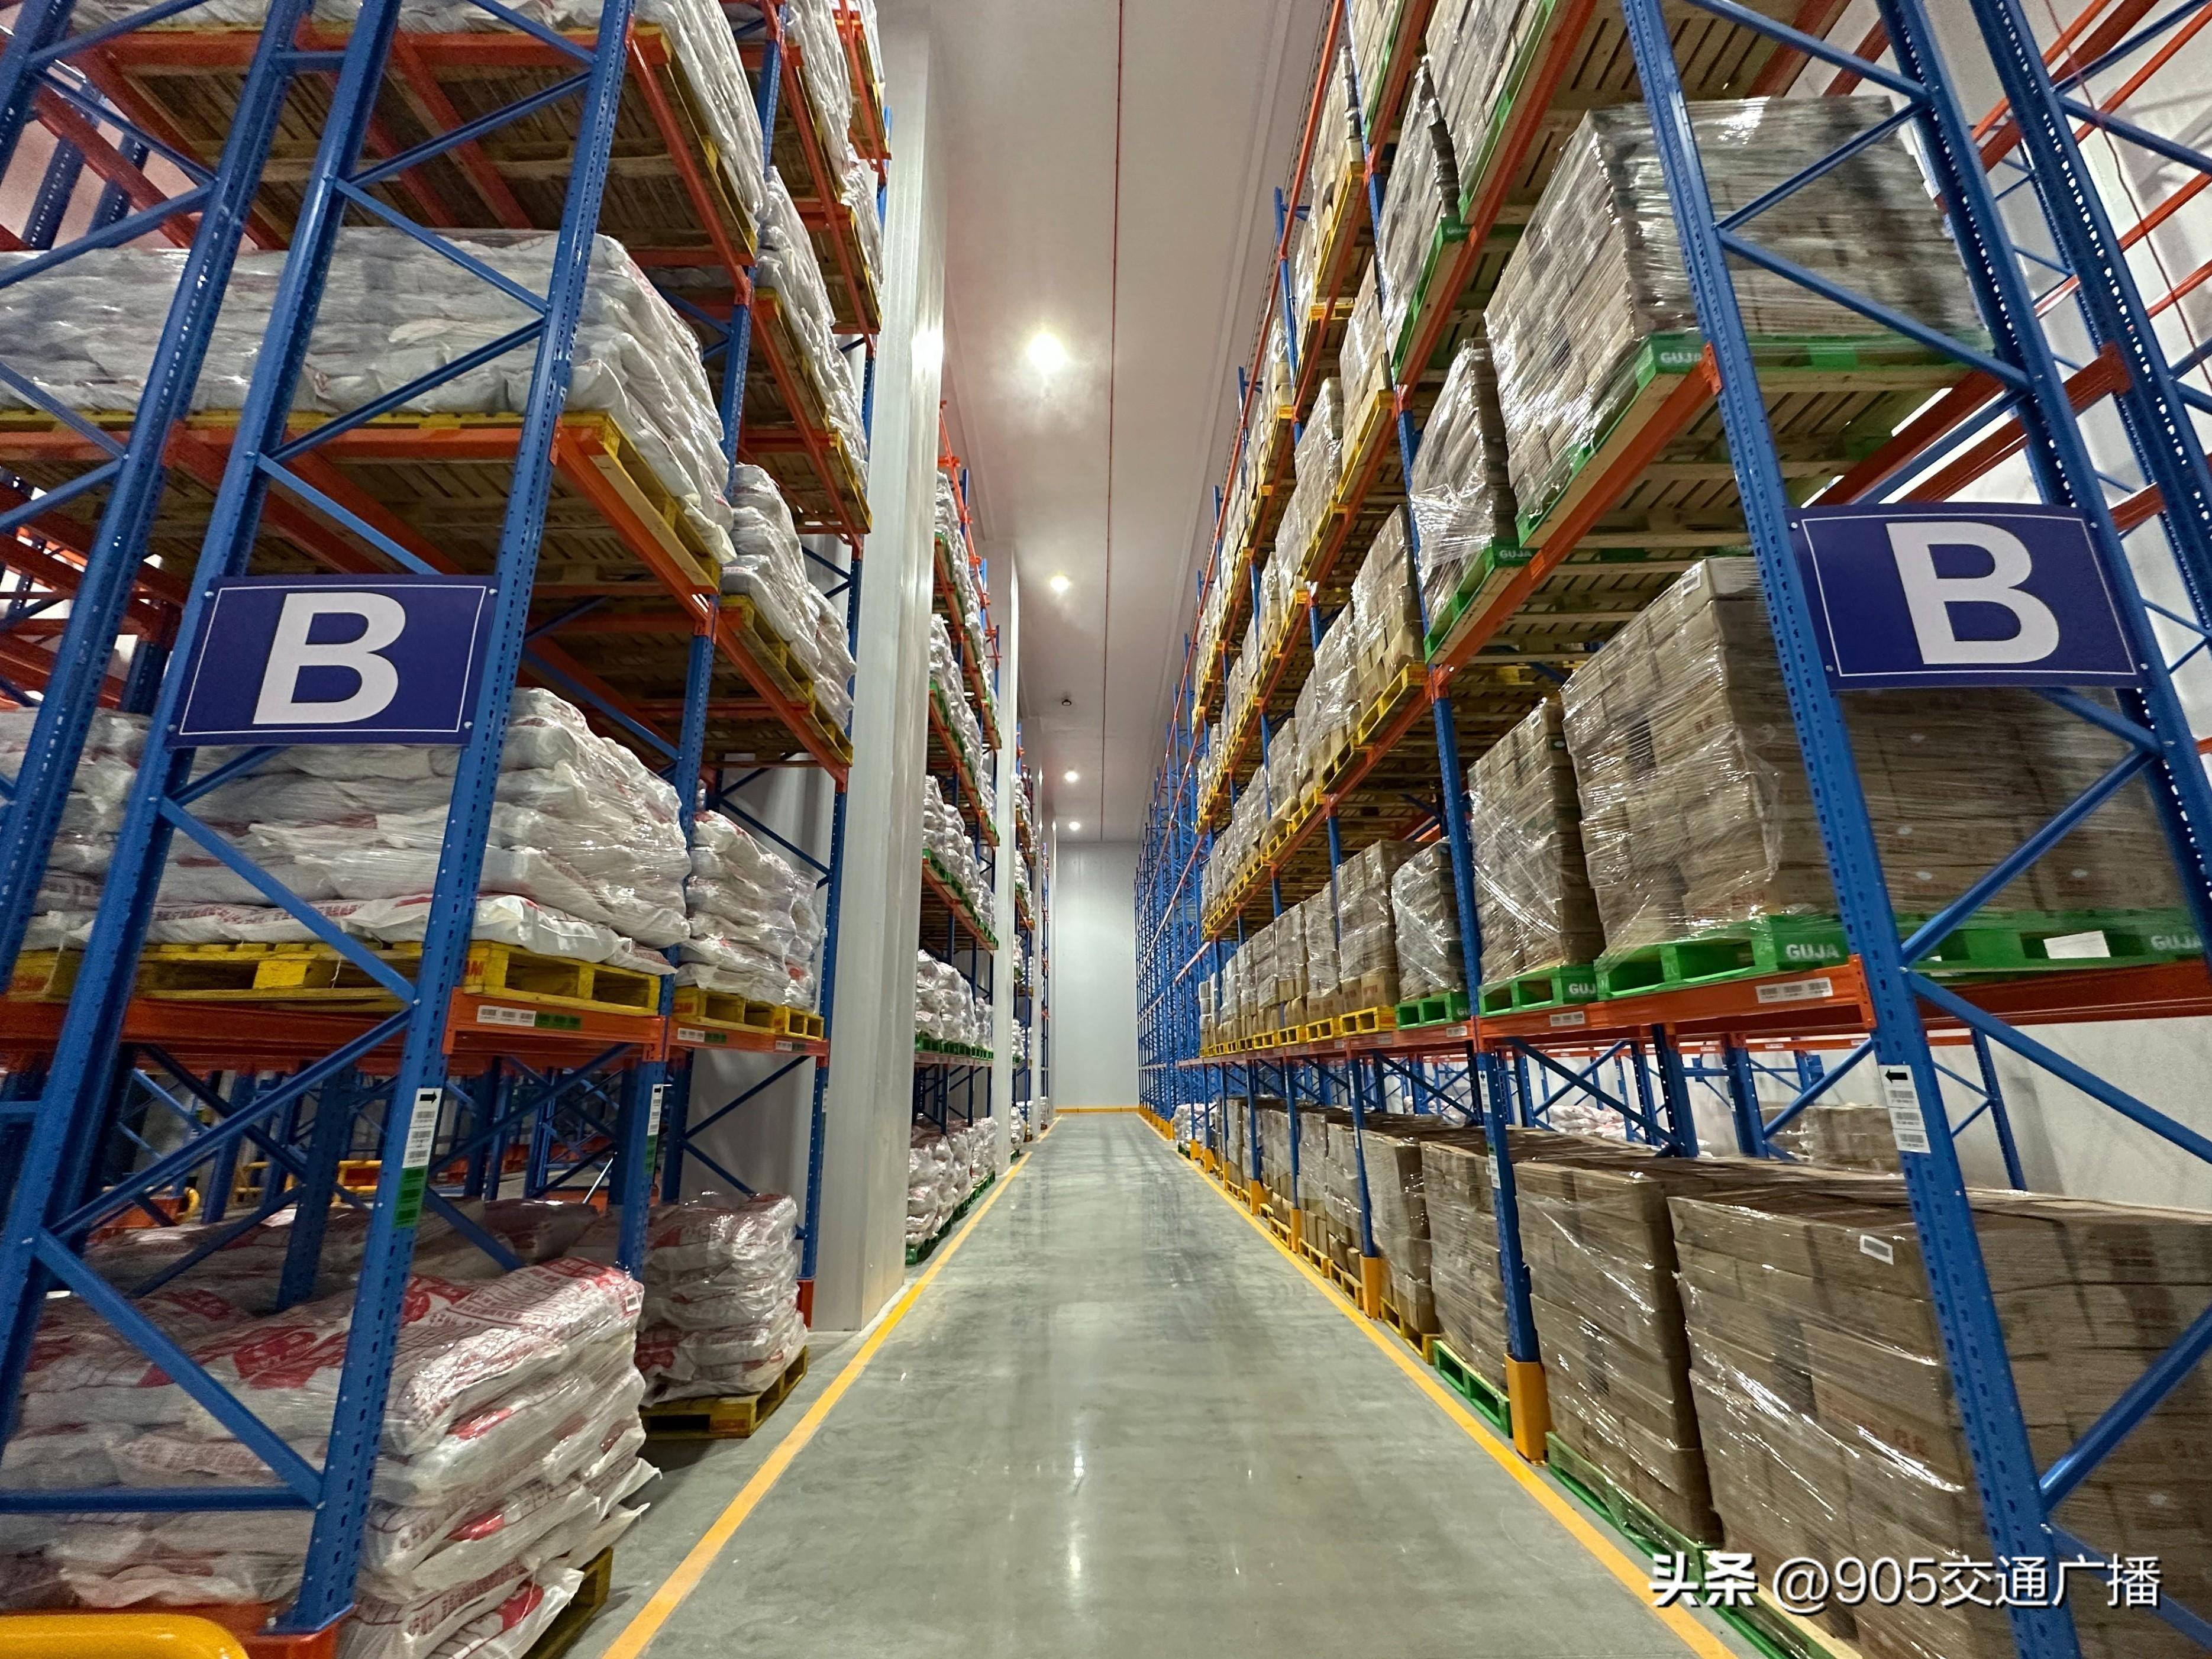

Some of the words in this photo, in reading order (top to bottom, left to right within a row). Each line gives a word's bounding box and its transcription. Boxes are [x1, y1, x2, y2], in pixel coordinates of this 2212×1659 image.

[1499, 549, 1532, 559] GUJA
[1885, 521, 2060, 665] B
[253, 592, 406, 724] B
[2150, 935, 2203, 950] GUJA
[1785, 943, 1840, 960] GUJA
[1568, 983, 1597, 995] GUJ
[1457, 1007, 1471, 1016] GU
